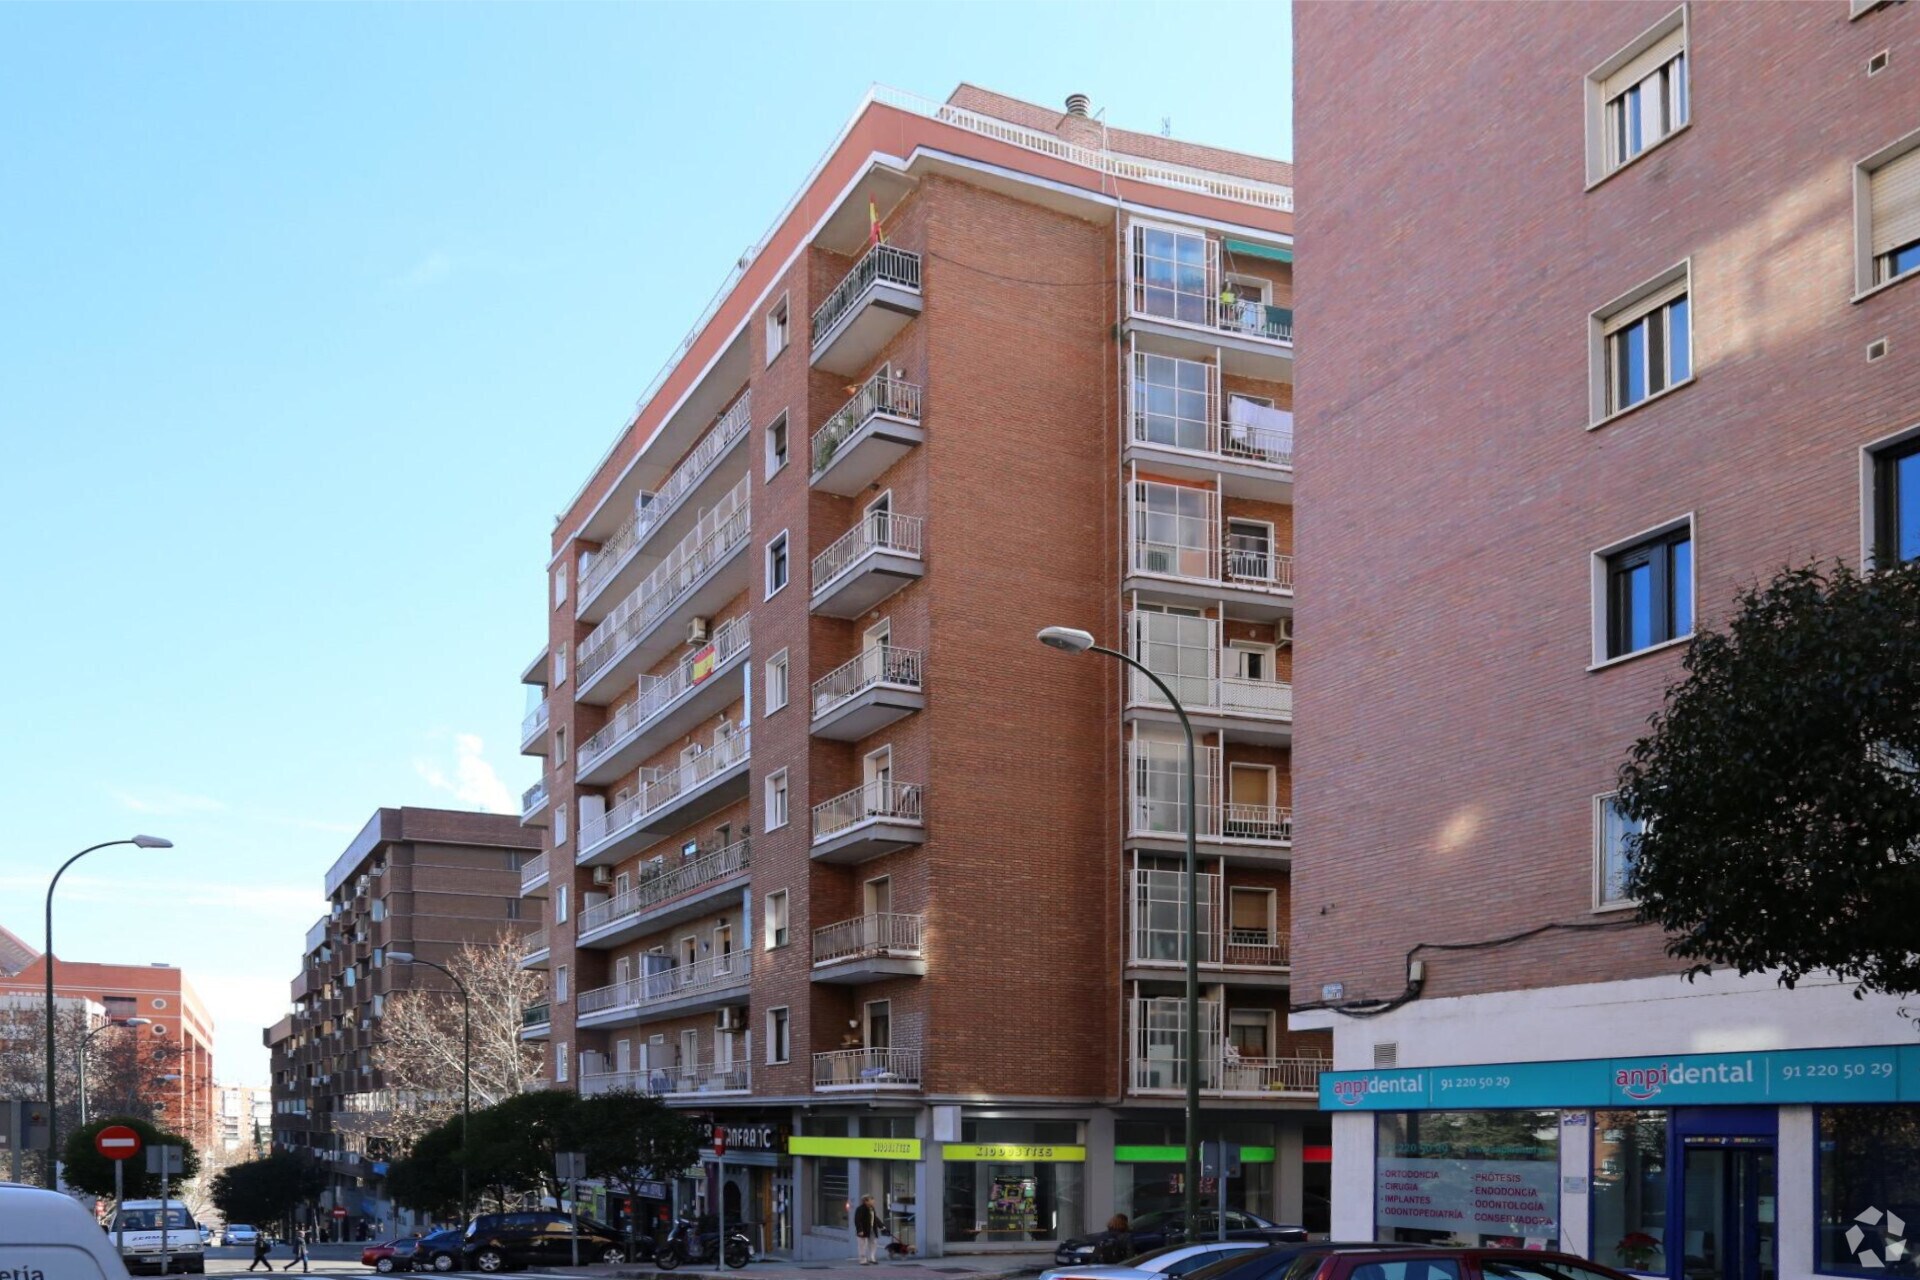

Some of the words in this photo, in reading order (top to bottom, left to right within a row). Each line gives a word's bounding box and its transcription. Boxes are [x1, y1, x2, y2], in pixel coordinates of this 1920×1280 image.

[1616, 1059, 1753, 1090] anpidental
[1783, 1066, 1801, 1080] 91
[1806, 1065, 1838, 1077] 220
[1844, 1064, 1865, 1079] 50
[1871, 1063, 1893, 1078] 29
[1334, 1074, 1423, 1097] anpidental
[1441, 1078, 1453, 1091] 91
[1456, 1077, 1476, 1088] 220
[1479, 1076, 1492, 1088] 50
[1496, 1076, 1510, 1089] 29
[1385, 1169, 1439, 1179] ORTODONCIA
[1475, 1186, 1537, 1197] ENDODONCIA
[1384, 1195, 1431, 1205] IMPLANTES
[1475, 1199, 1544, 1211] ODONTOLOGÍA
[1384, 1207, 1463, 1219] ODONTOPEDIATRÍA
